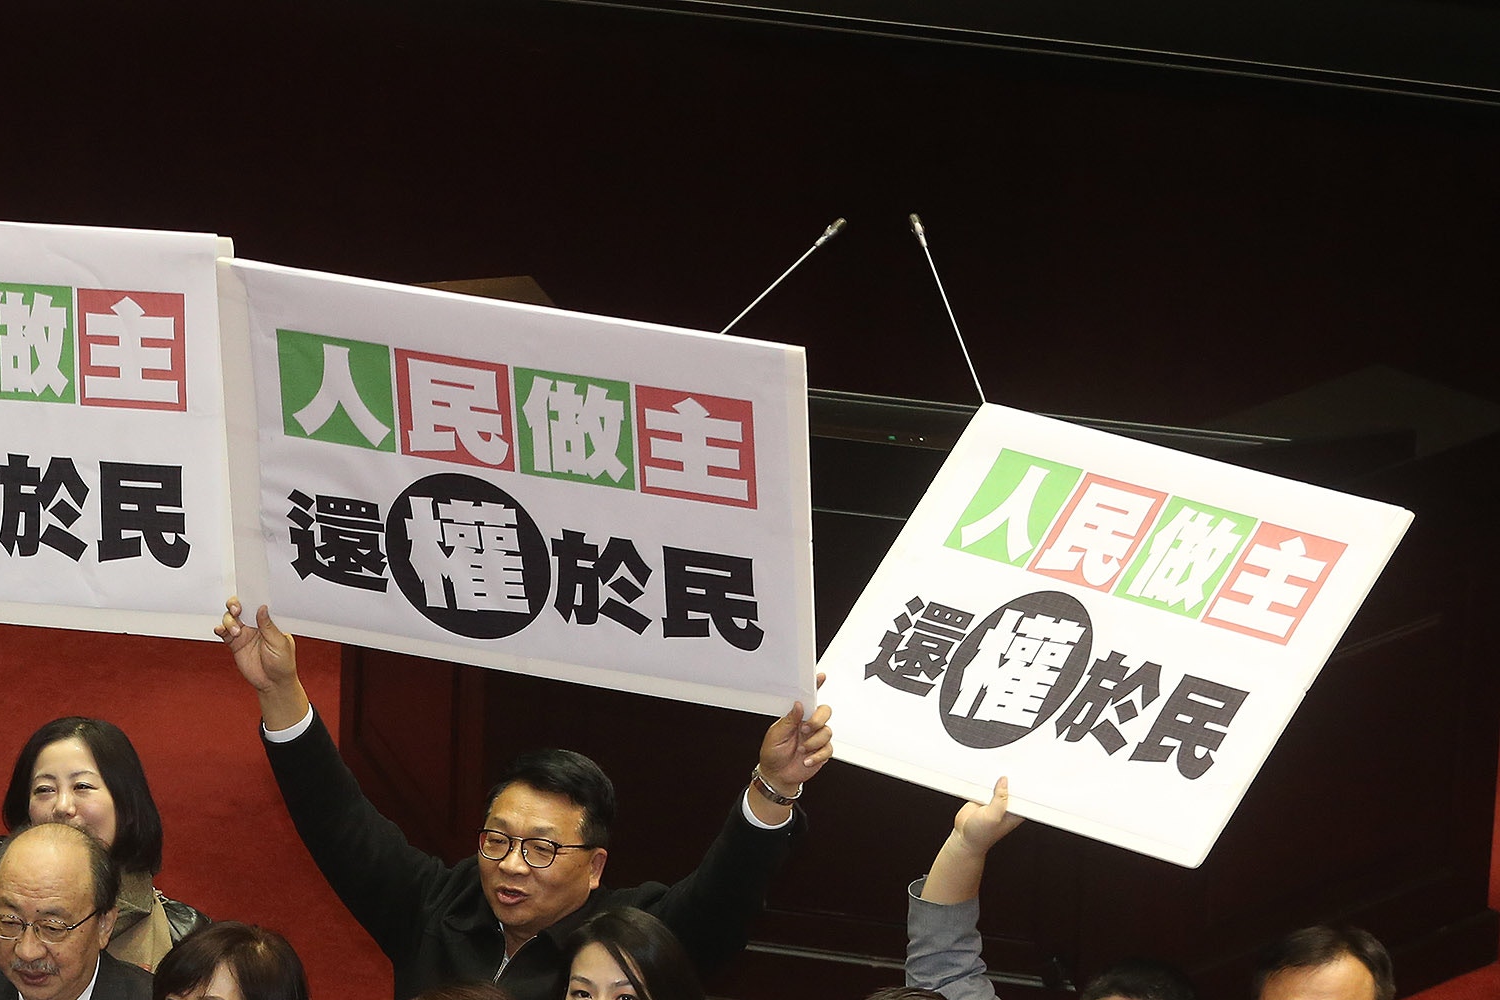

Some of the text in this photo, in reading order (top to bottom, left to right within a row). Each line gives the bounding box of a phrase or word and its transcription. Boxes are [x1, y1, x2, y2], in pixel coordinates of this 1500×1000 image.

[292, 343, 749, 502] 人民做主
[286, 488, 765, 651] 還權於民
[960, 464, 1329, 639] 人民做主
[864, 595, 1250, 780] 還權於民
